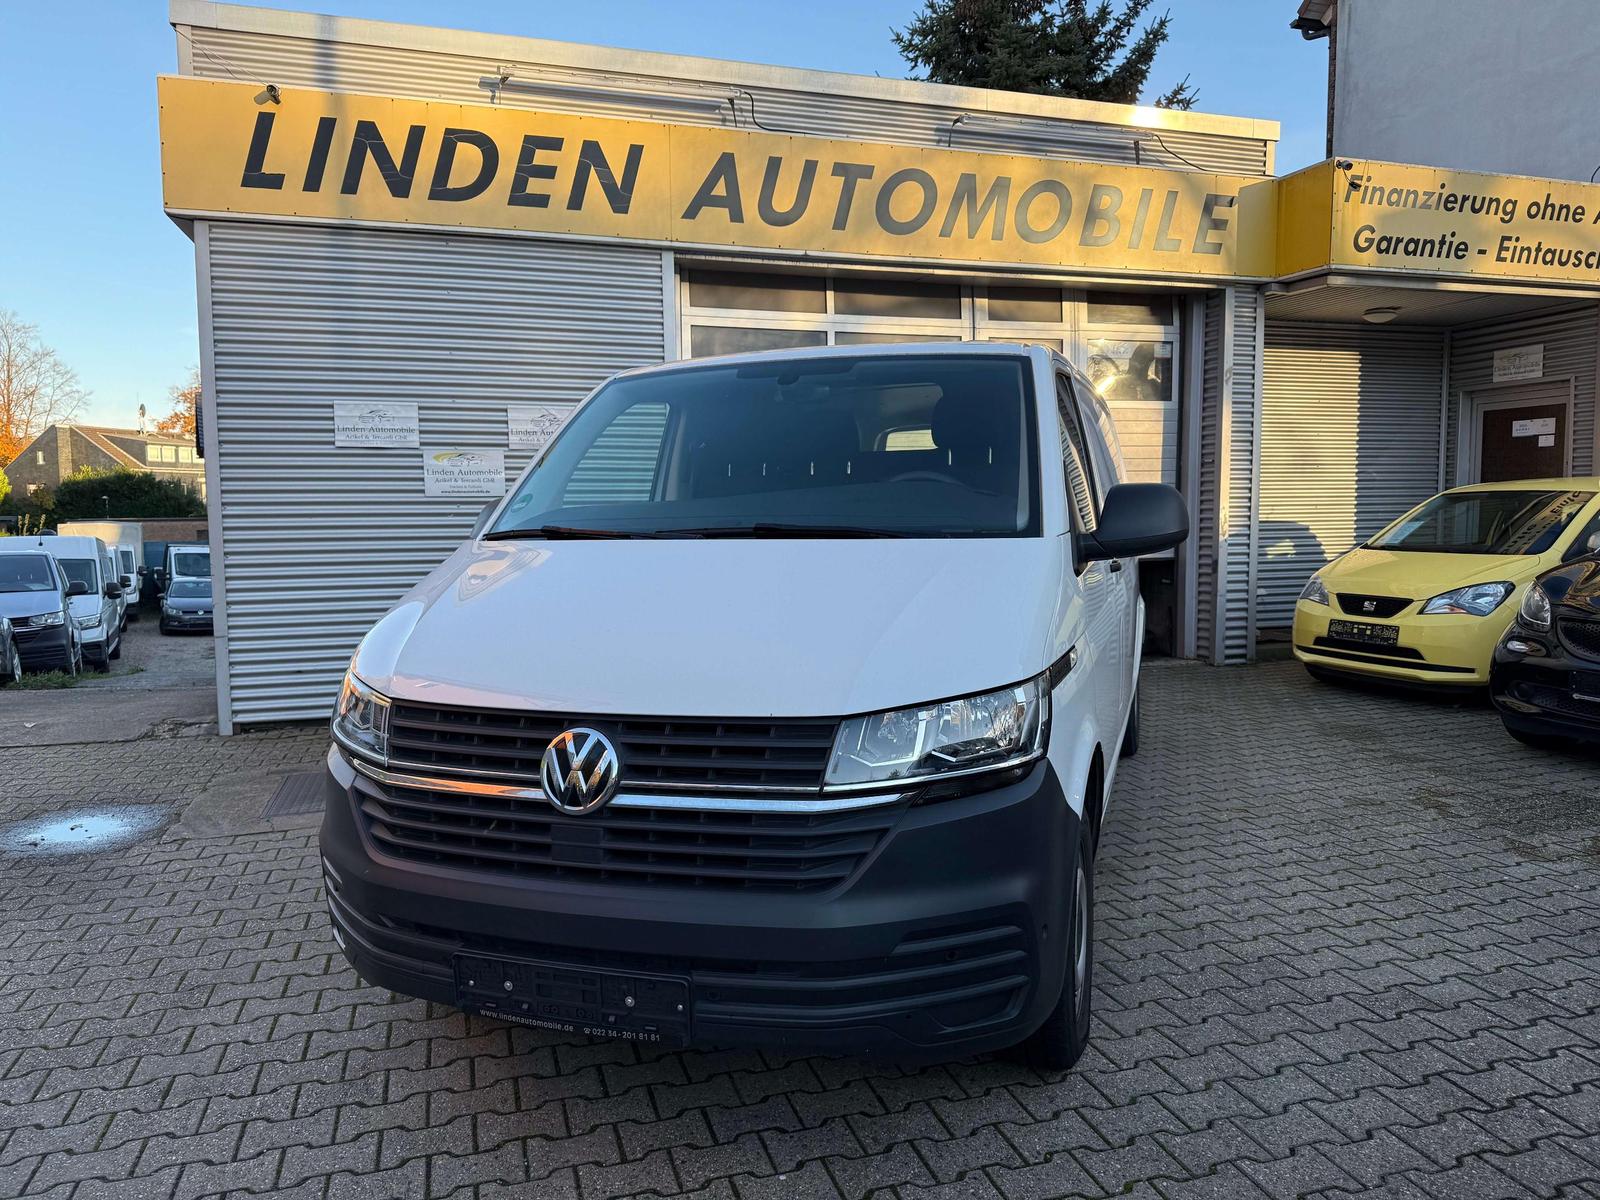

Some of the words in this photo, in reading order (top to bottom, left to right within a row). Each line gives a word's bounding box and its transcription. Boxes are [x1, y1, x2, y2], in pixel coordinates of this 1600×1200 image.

[240, 111, 644, 215] LINDEN
[681, 151, 1237, 256] AUTOMOBILE
[1344, 174, 1518, 224] Finanzierung
[1526, 193, 1586, 223] ohne
[1353, 224, 1469, 260] Garantie
[337, 425, 366, 433] Linden
[368, 426, 416, 434] Automobile
[511, 428, 537, 436] Linden
[426, 468, 455, 476] Linden
[457, 468, 503, 476] Automobile
[480, 1008, 574, 1032] www.lindenautomobile.de
